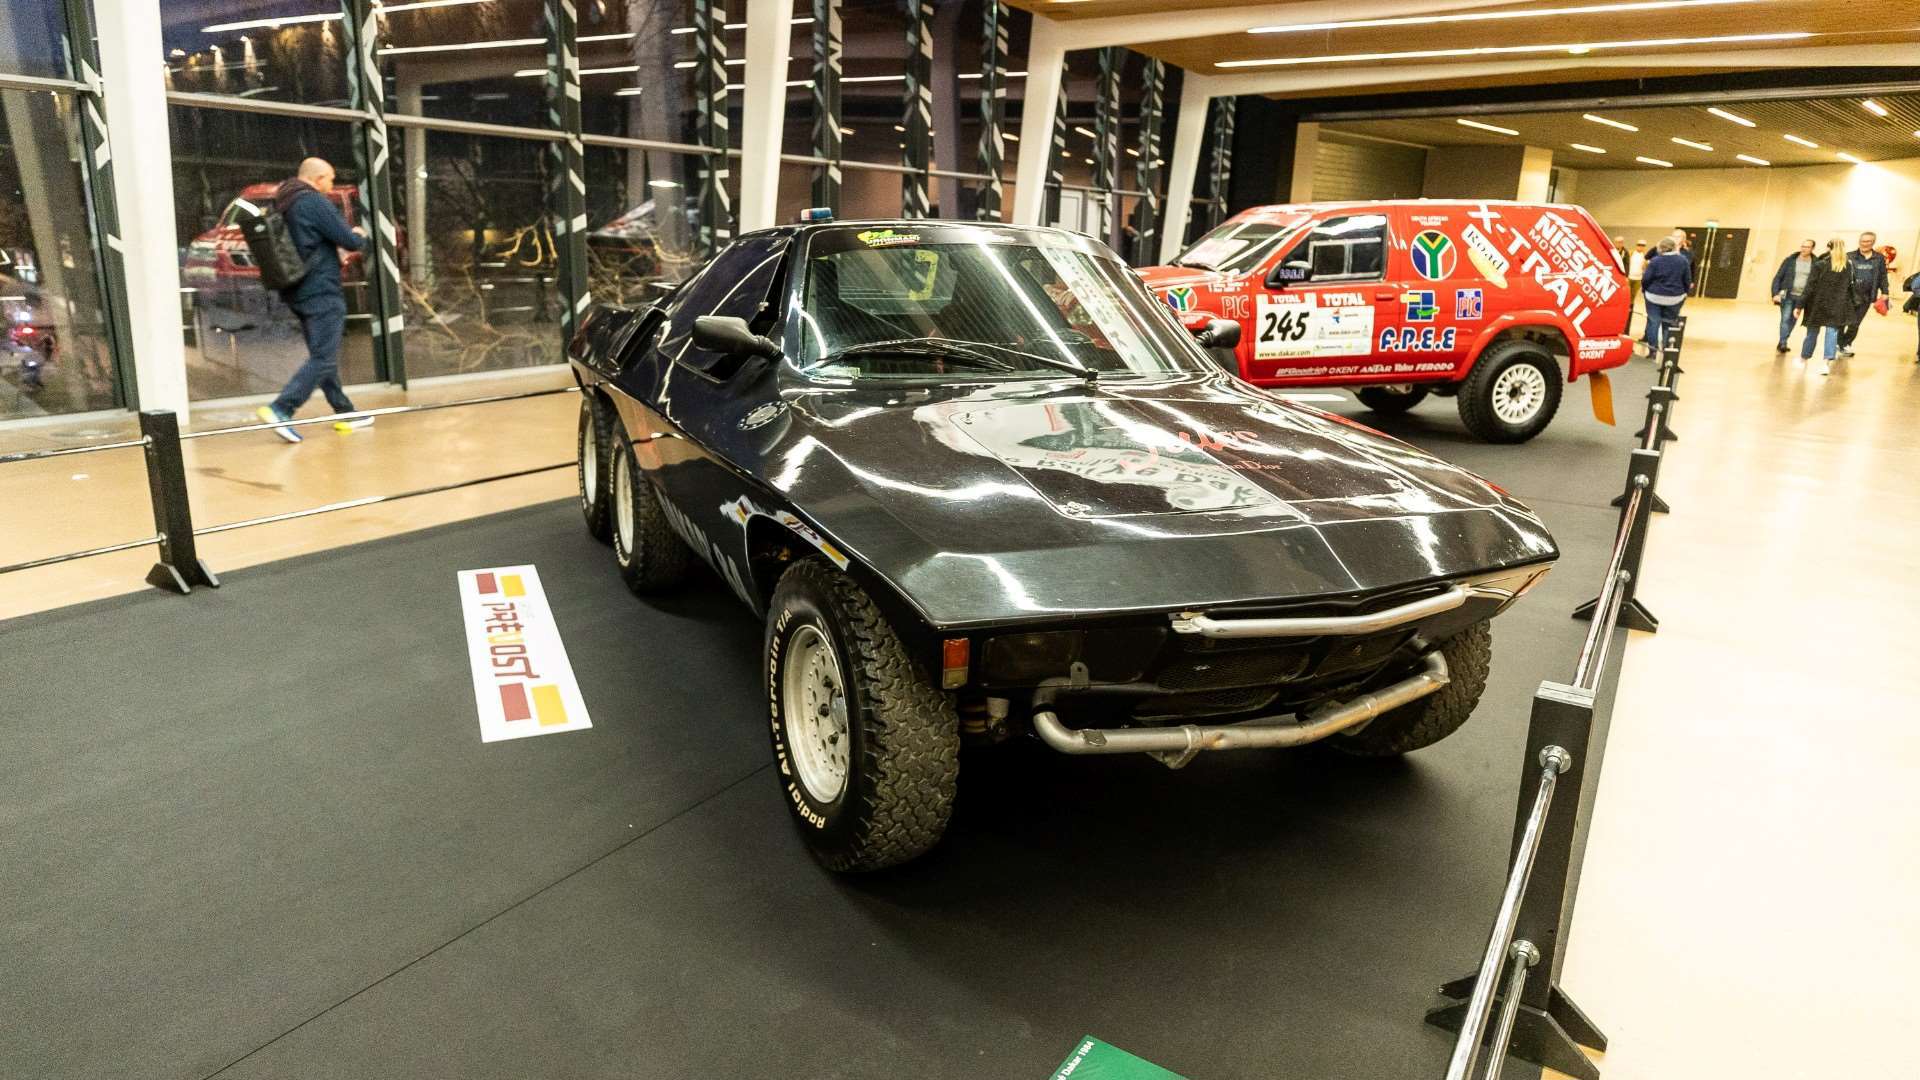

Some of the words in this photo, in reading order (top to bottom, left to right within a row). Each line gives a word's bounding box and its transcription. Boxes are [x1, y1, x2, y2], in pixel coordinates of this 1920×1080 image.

[1534, 213, 1617, 302] NISSAN
[1467, 204, 1591, 338] X-TRAIL
[1221, 295, 1250, 318] PIC
[1272, 294, 1302, 304] TOTAL
[1322, 292, 1366, 306] TOTAL
[1260, 310, 1310, 342] 245
[1259, 350, 1311, 358] www.dakar.com
[1415, 362, 1455, 372] FERODO
[776, 608, 793, 634] T/A
[788, 782, 826, 829] Radial
